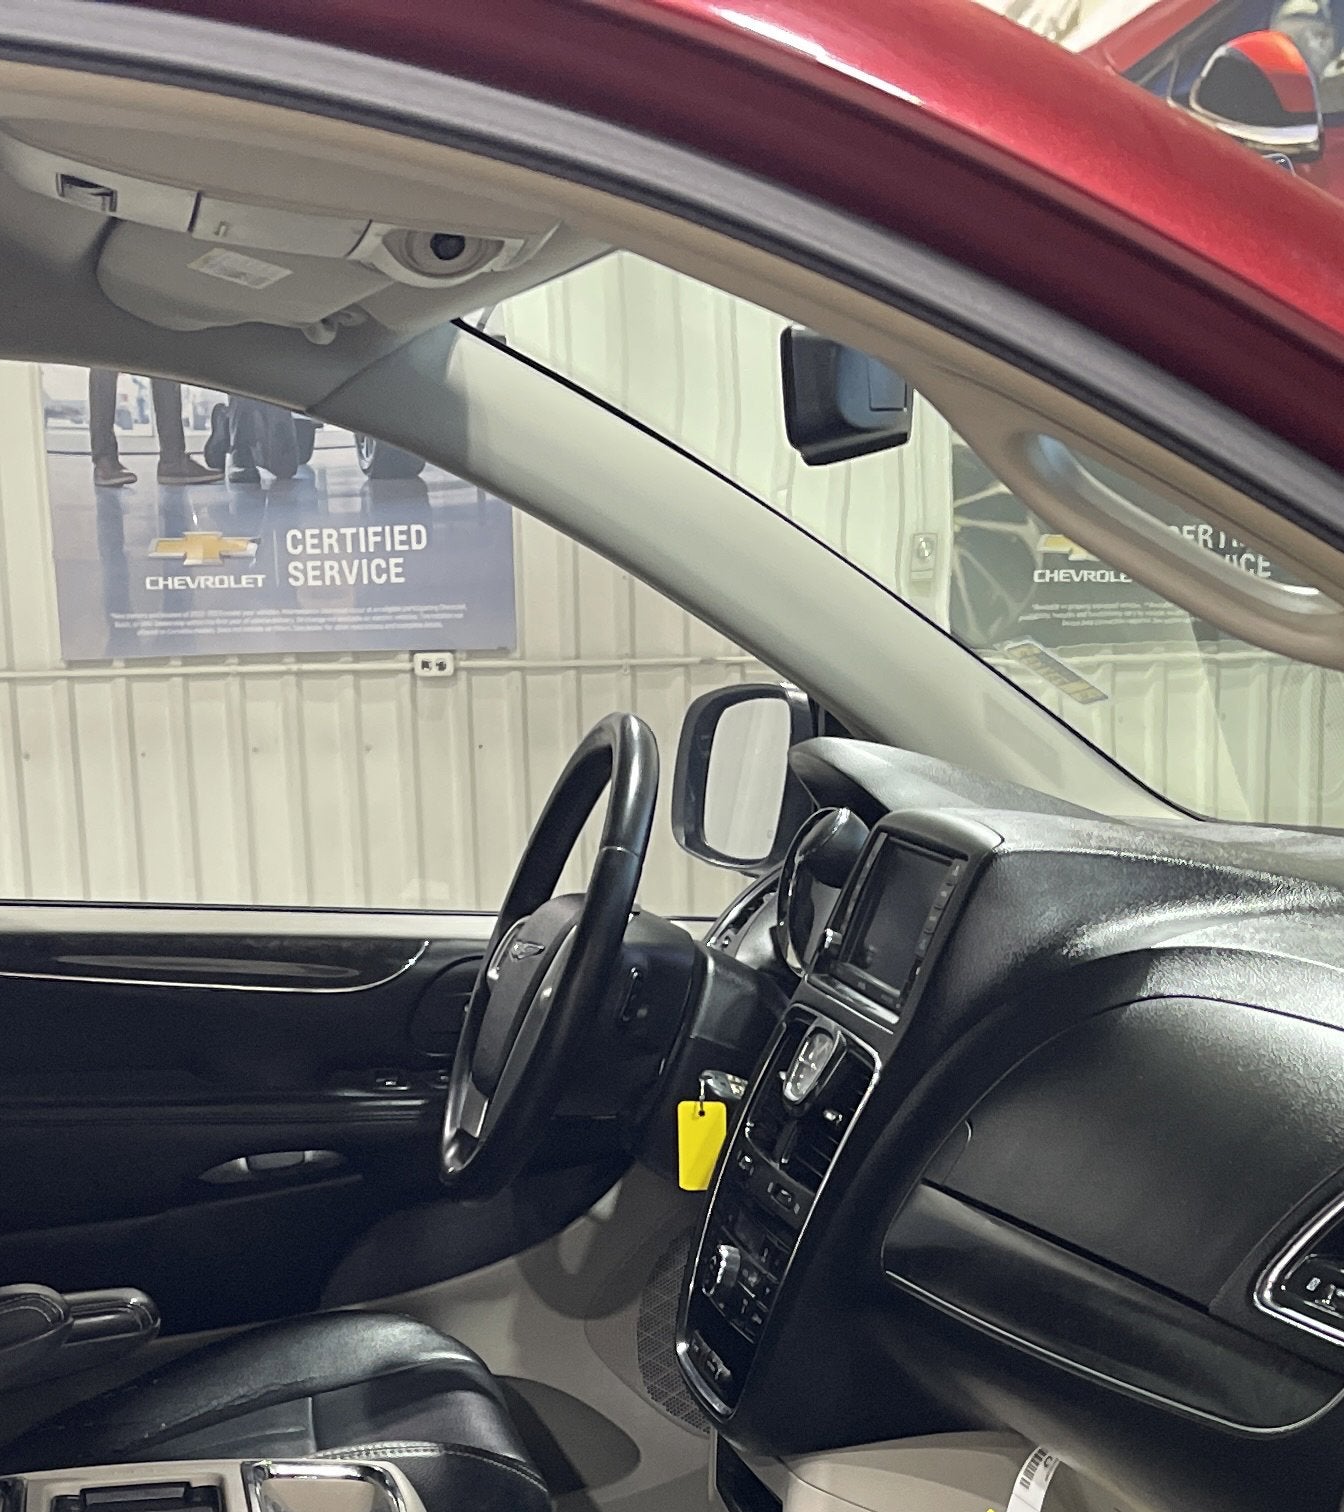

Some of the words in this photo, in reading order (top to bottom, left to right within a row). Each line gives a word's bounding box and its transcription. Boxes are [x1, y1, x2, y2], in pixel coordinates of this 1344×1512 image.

[286, 524, 427, 555] CERTIFIED
[145, 574, 266, 590] CHEVROLET
[288, 557, 406, 587] SERVICE
[1033, 569, 1133, 583] CHEVROLE
